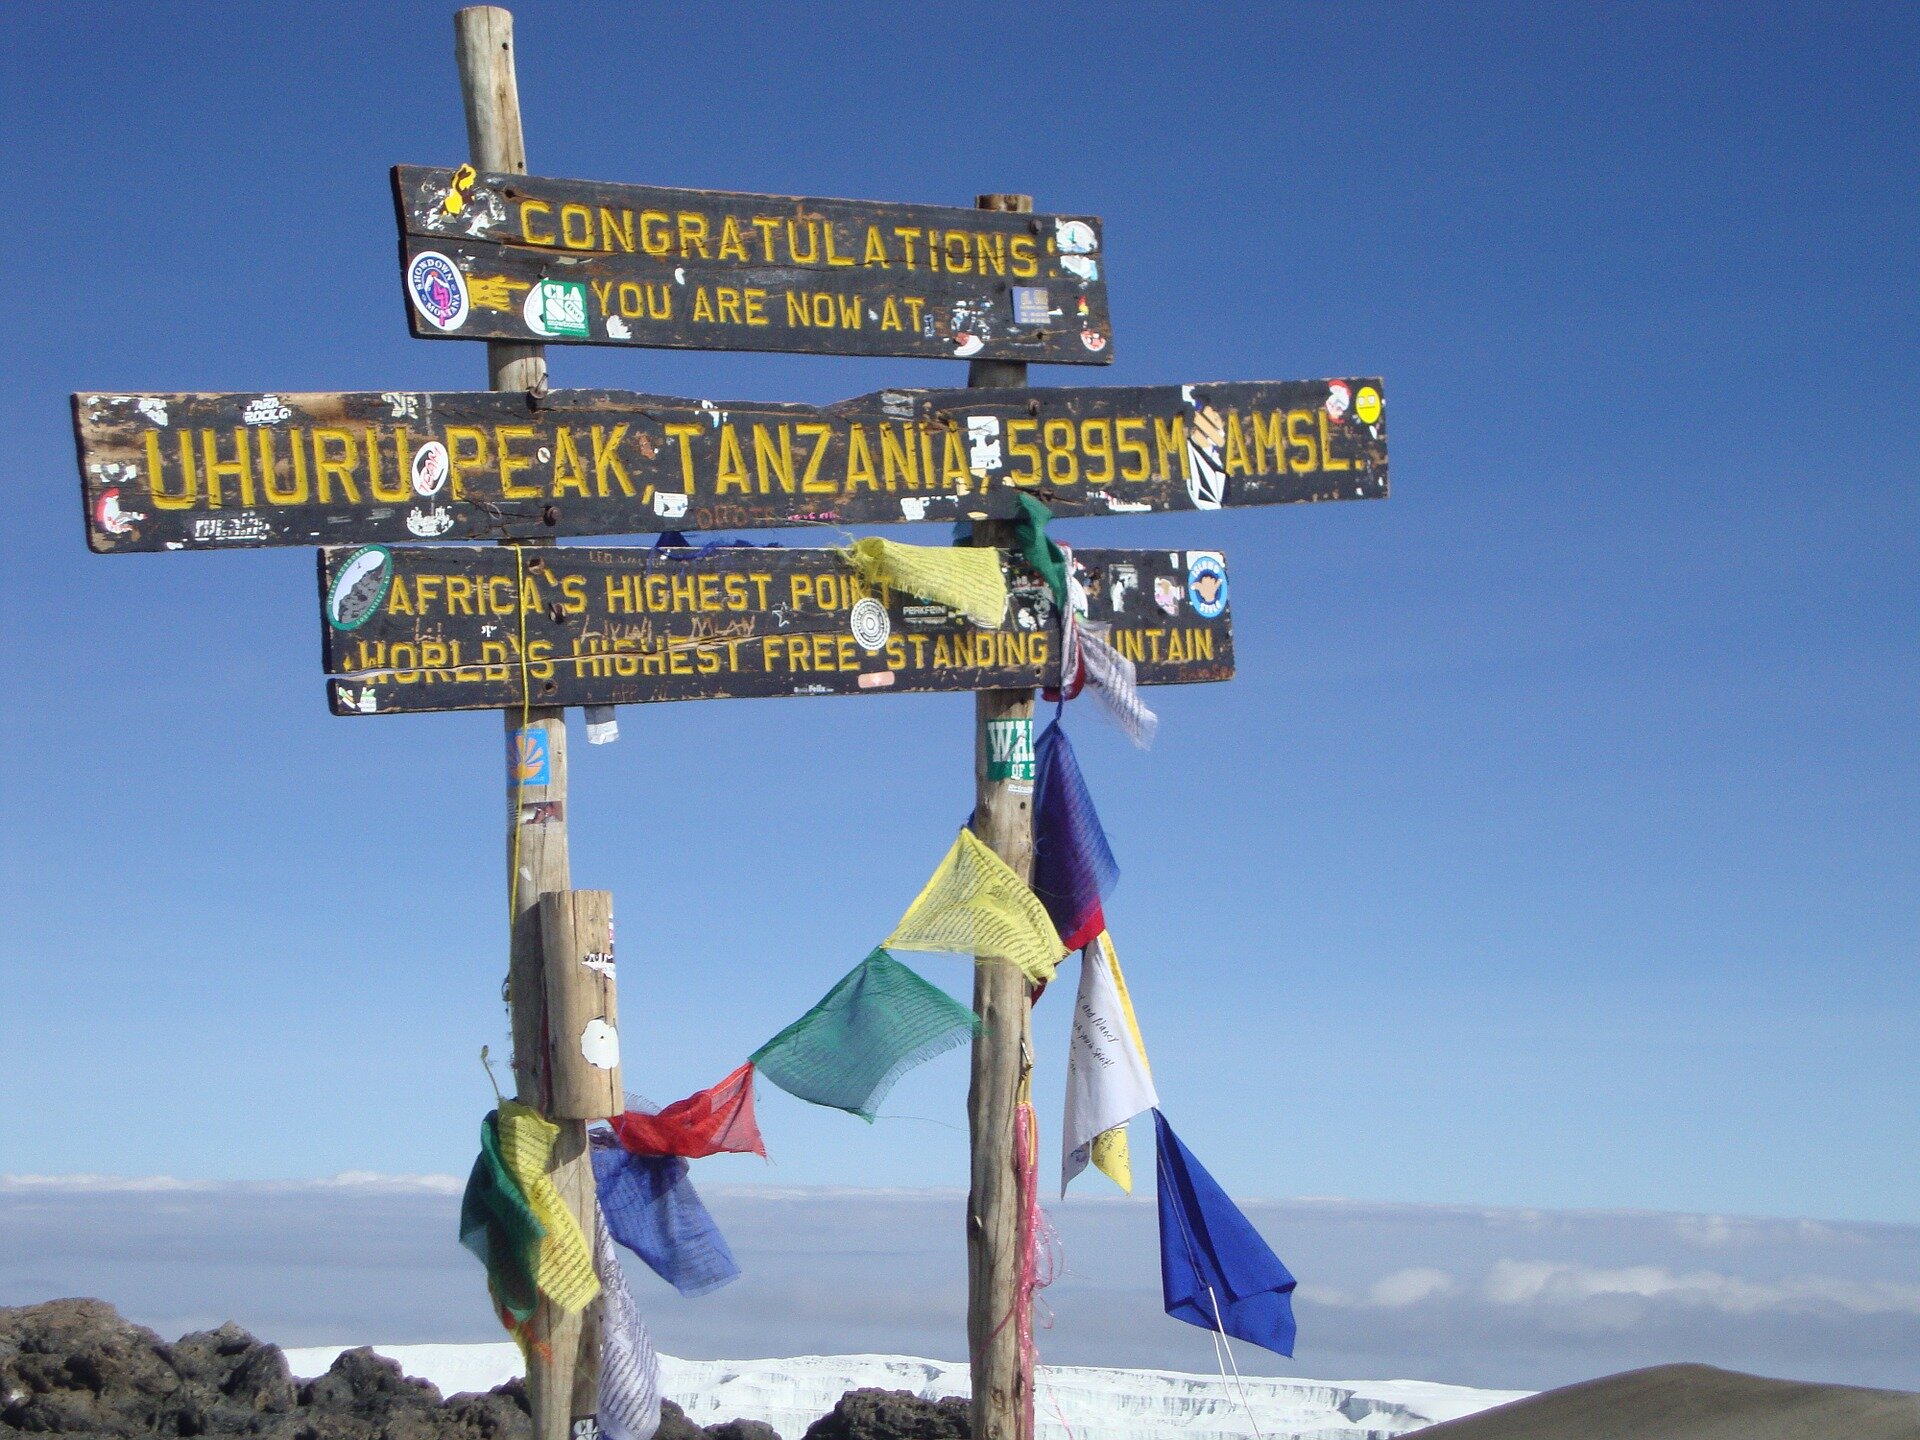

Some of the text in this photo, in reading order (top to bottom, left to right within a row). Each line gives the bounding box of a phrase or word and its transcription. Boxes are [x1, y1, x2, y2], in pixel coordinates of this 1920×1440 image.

[413, 258, 454, 291] SHOWDOWN
[590, 278, 925, 332] YOU ARE NOW AT
[145, 425, 411, 511] UHURU
[444, 422, 655, 506] PEAK,
[664, 418, 991, 496] TANZANIA,
[1225, 407, 1365, 476] AMSL.
[388, 572, 588, 616] AFRICA'S
[605, 572, 773, 614] HIGHEST
[358, 632, 556, 686] WORLD'S
[573, 636, 747, 678] HIGHEST
